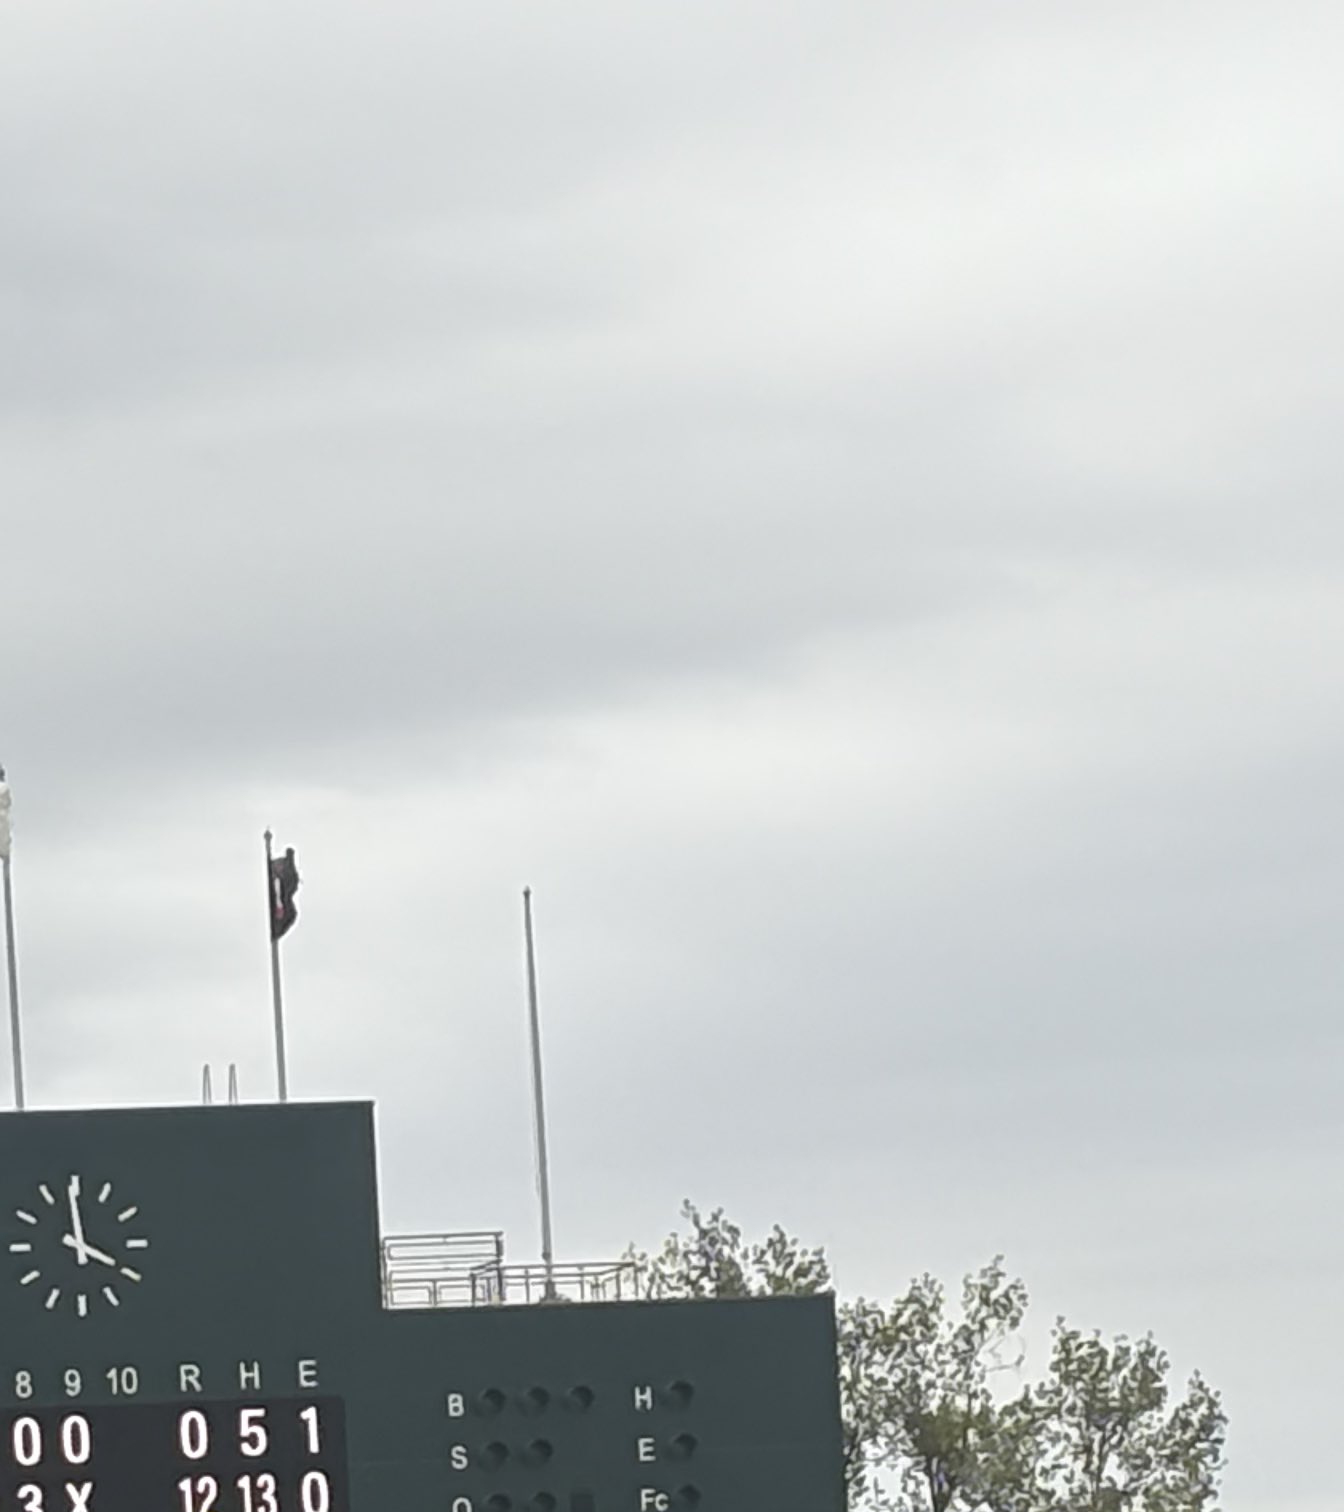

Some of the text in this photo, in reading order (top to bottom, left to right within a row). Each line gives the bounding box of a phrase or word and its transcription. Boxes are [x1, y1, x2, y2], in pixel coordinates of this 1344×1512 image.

[16, 1371, 32, 1398] 8
[65, 1370, 81, 1396] 9
[107, 1367, 137, 1394] 10
[180, 1365, 201, 1391] R
[240, 1362, 260, 1389] H
[299, 1360, 317, 1387] E
[448, 1394, 464, 1416] B
[635, 1387, 651, 1409] H
[14, 1417, 41, 1466] 0
[62, 1415, 90, 1464] 0
[180, 1411, 208, 1459] 0
[240, 1409, 267, 1456] 5
[300, 1406, 319, 1453] 1
[452, 1446, 467, 1469] S
[639, 1438, 655, 1461] E
